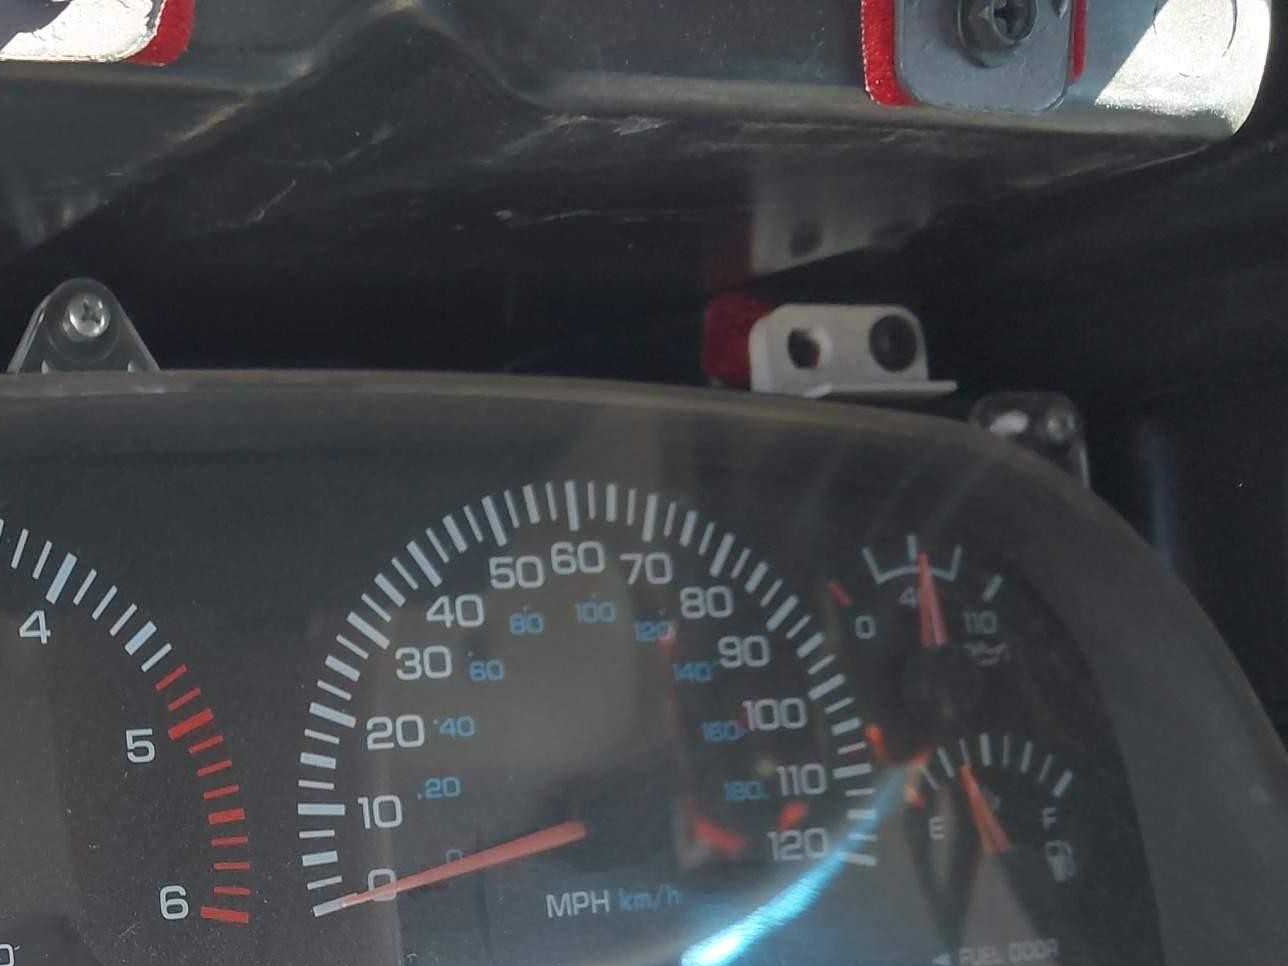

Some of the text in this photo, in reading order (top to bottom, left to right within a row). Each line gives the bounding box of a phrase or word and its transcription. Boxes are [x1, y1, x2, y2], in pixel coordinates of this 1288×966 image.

[489, 556, 545, 590] 50
[550, 541, 606, 575] 60
[620, 552, 673, 585] 70
[426, 594, 485, 628] 40
[575, 602, 616, 624] 100
[679, 586, 735, 619] 80
[19, 610, 52, 646] 4
[509, 614, 544, 635] 80
[855, 615, 876, 640] 0
[395, 645, 453, 680] 30
[718, 635, 771, 668] 90
[469, 660, 505, 682] 60
[439, 717, 476, 738] 40
[742, 698, 808, 732] 100
[126, 727, 156, 763] 5
[367, 715, 426, 750] 20
[424, 776, 461, 798] 20
[776, 762, 828, 797] 110
[357, 794, 403, 829] 10
[767, 827, 830, 861] 120
[367, 867, 398, 902] 0
[159, 884, 190, 920] 6
[545, 891, 611, 919] MPH
